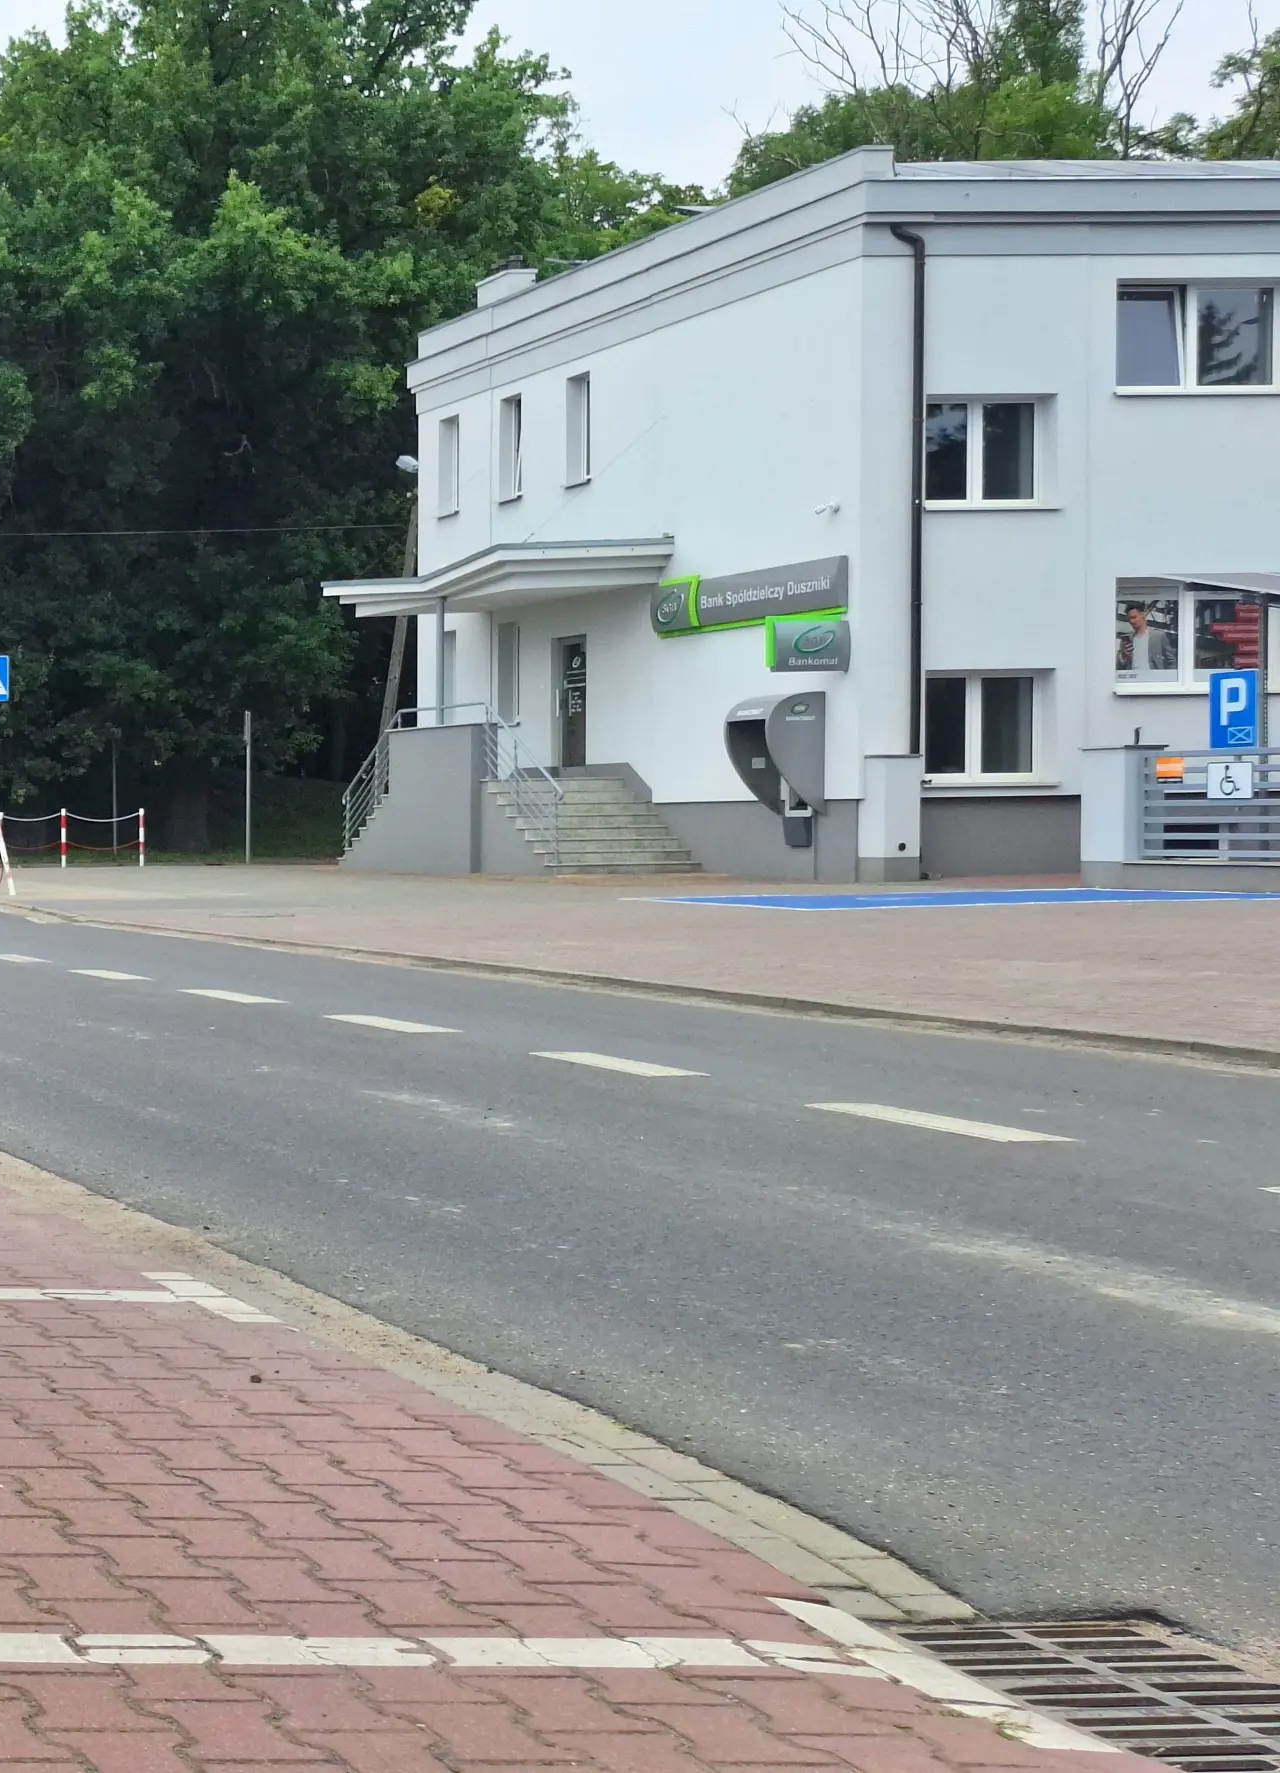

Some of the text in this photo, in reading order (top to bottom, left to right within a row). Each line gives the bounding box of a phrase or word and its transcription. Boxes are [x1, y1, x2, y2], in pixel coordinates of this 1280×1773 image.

[701, 575, 830, 609] Bank Spółdzielczy Duszniki
[788, 656, 838, 666] Bankomat
[1220, 678, 1246, 726] P
